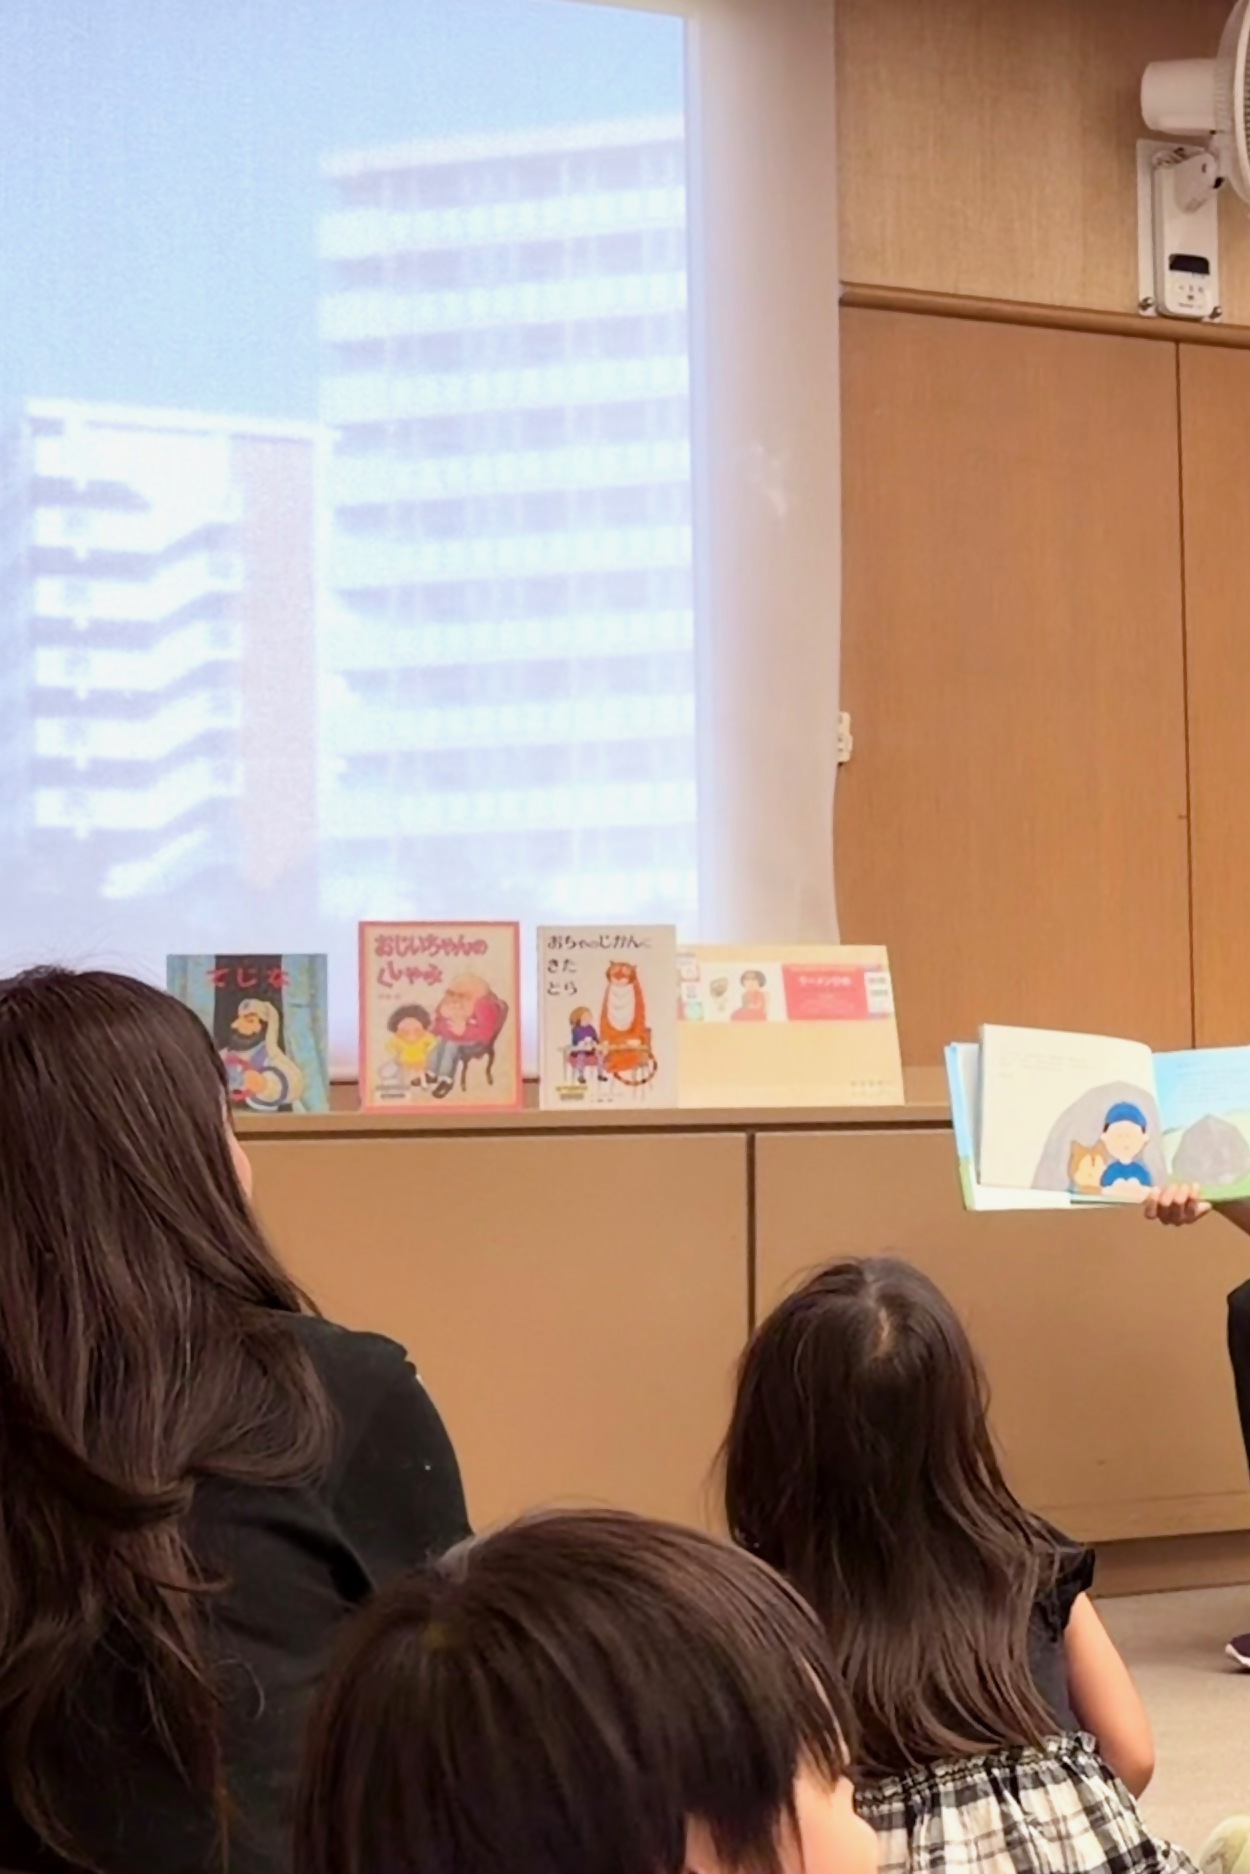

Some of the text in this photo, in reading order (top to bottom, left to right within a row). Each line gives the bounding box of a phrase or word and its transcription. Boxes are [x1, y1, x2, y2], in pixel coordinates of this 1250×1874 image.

[374, 933, 489, 958] おじいちゃんの
[206, 966, 291, 989] てじな
[376, 960, 443, 989] くしゃみ
[546, 958, 577, 975] きた
[546, 980, 578, 997] とら
